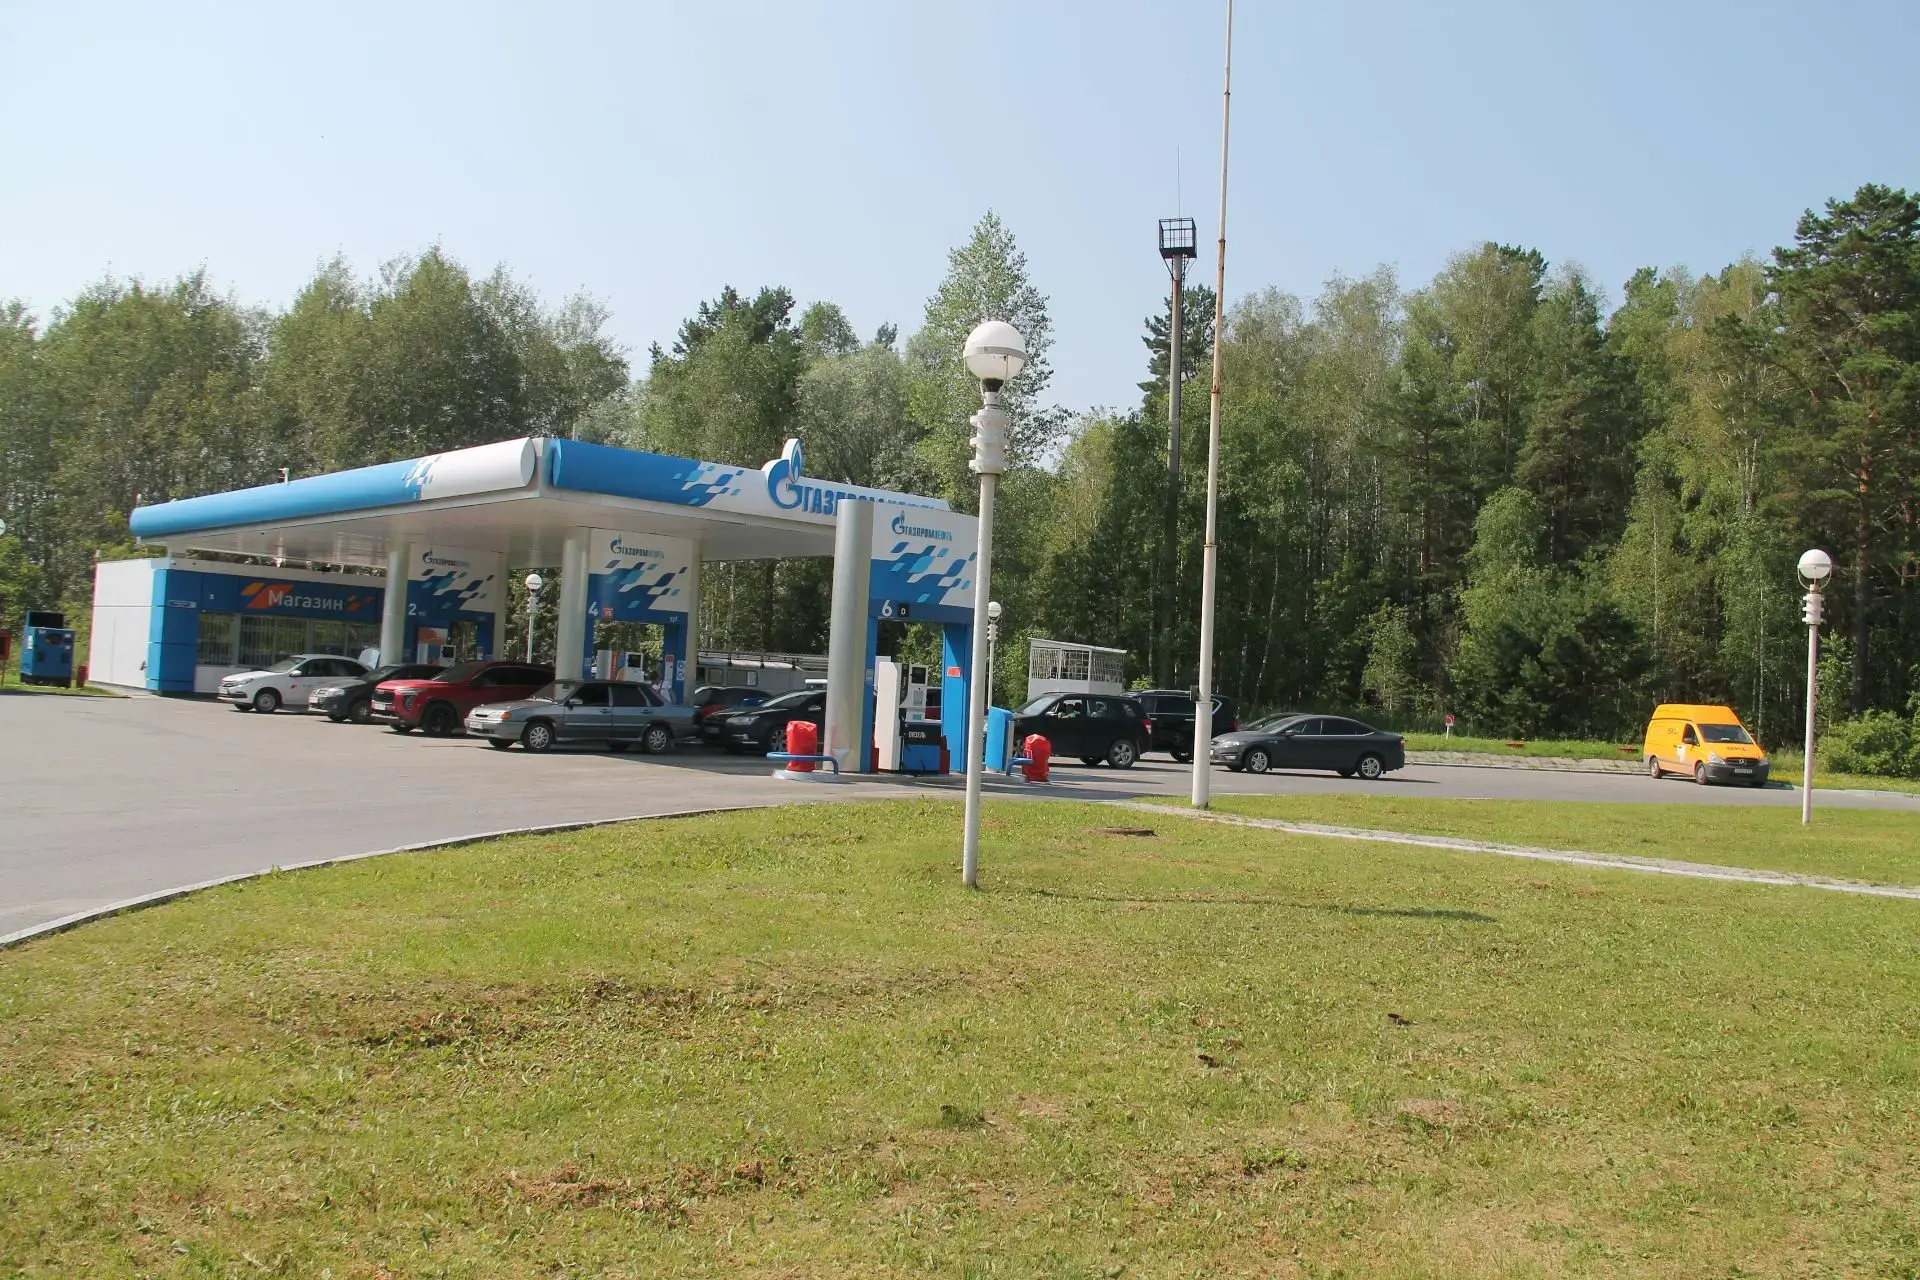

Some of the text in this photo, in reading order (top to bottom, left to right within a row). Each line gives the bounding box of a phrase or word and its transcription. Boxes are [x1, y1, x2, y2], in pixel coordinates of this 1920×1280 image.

[268, 589, 344, 611] Магазин
[881, 599, 893, 617] 6
[407, 602, 418, 616] 2
[588, 601, 599, 617] 4
